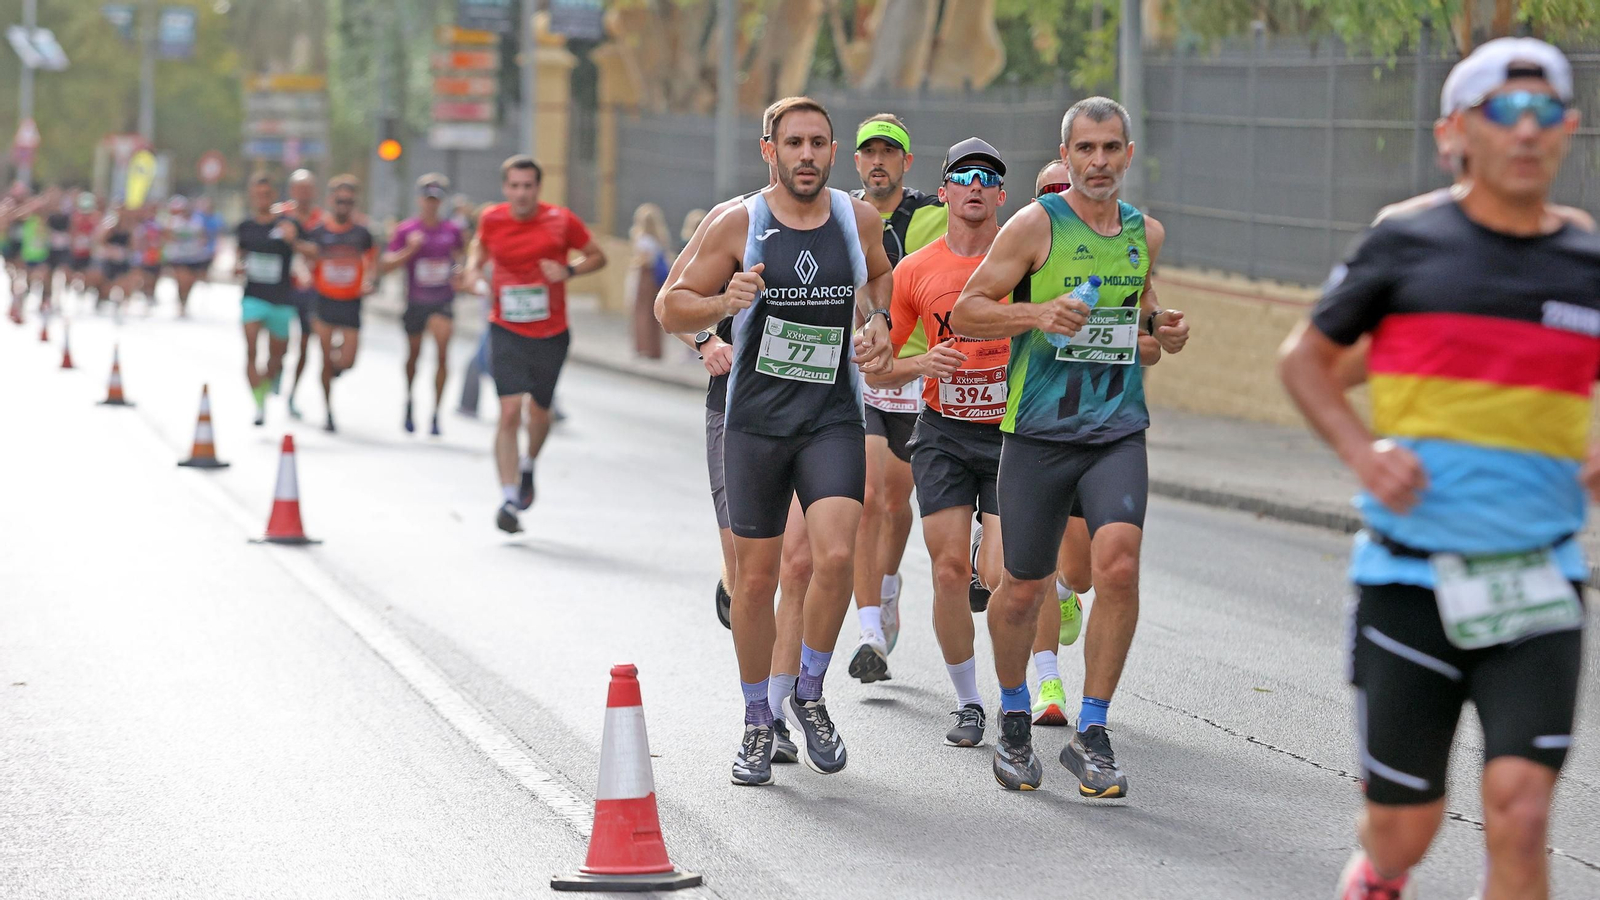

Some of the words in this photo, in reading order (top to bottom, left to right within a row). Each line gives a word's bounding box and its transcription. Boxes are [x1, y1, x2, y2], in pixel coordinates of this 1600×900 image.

[760, 288, 807, 299] MOTOR
[810, 285, 853, 299] ARCOS
[1088, 327, 1114, 345] 75
[787, 342, 816, 363] 77
[785, 366, 831, 380] MIZUNO
[954, 386, 993, 403] 394
[966, 407, 1006, 417] MIZUNO
